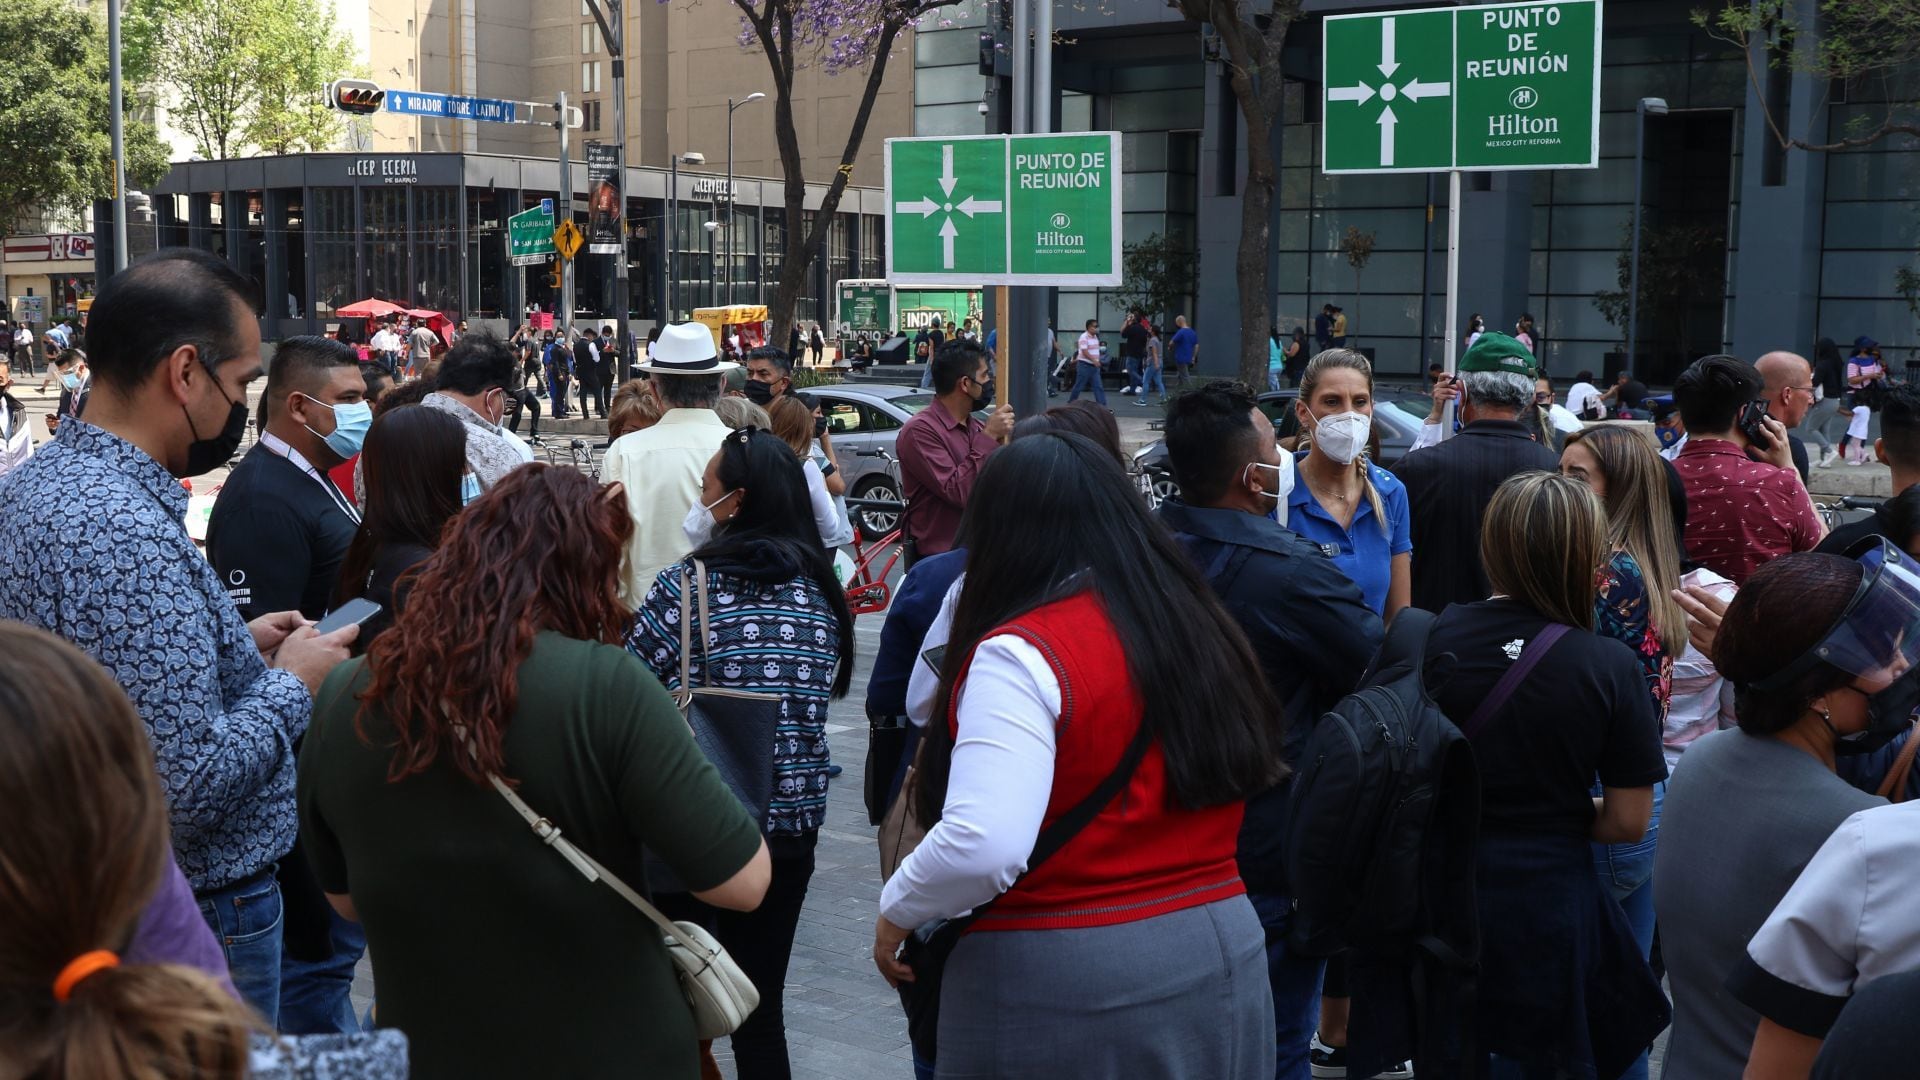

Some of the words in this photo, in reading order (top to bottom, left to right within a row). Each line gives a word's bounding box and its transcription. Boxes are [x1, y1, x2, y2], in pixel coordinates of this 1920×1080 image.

[1483, 6, 1561, 30] PUNTO
[1508, 32, 1538, 52] DE
[1466, 50, 1568, 79] REUNIÓN
[407, 96, 442, 113] MIRADOR
[447, 100, 471, 115] TORRE
[475, 103, 500, 117] LATINO
[1488, 113, 1559, 136] Hilton
[1529, 137, 1561, 145] REFORMA
[1015, 152, 1076, 170] PUNTO
[1081, 151, 1105, 168] DE
[347, 166, 356, 176] LA
[1020, 168, 1100, 189] REUNIÓN
[700, 178, 738, 195] CERVECEIA
[1036, 231, 1084, 246] Hilton
[906, 311, 942, 328] INDIO
